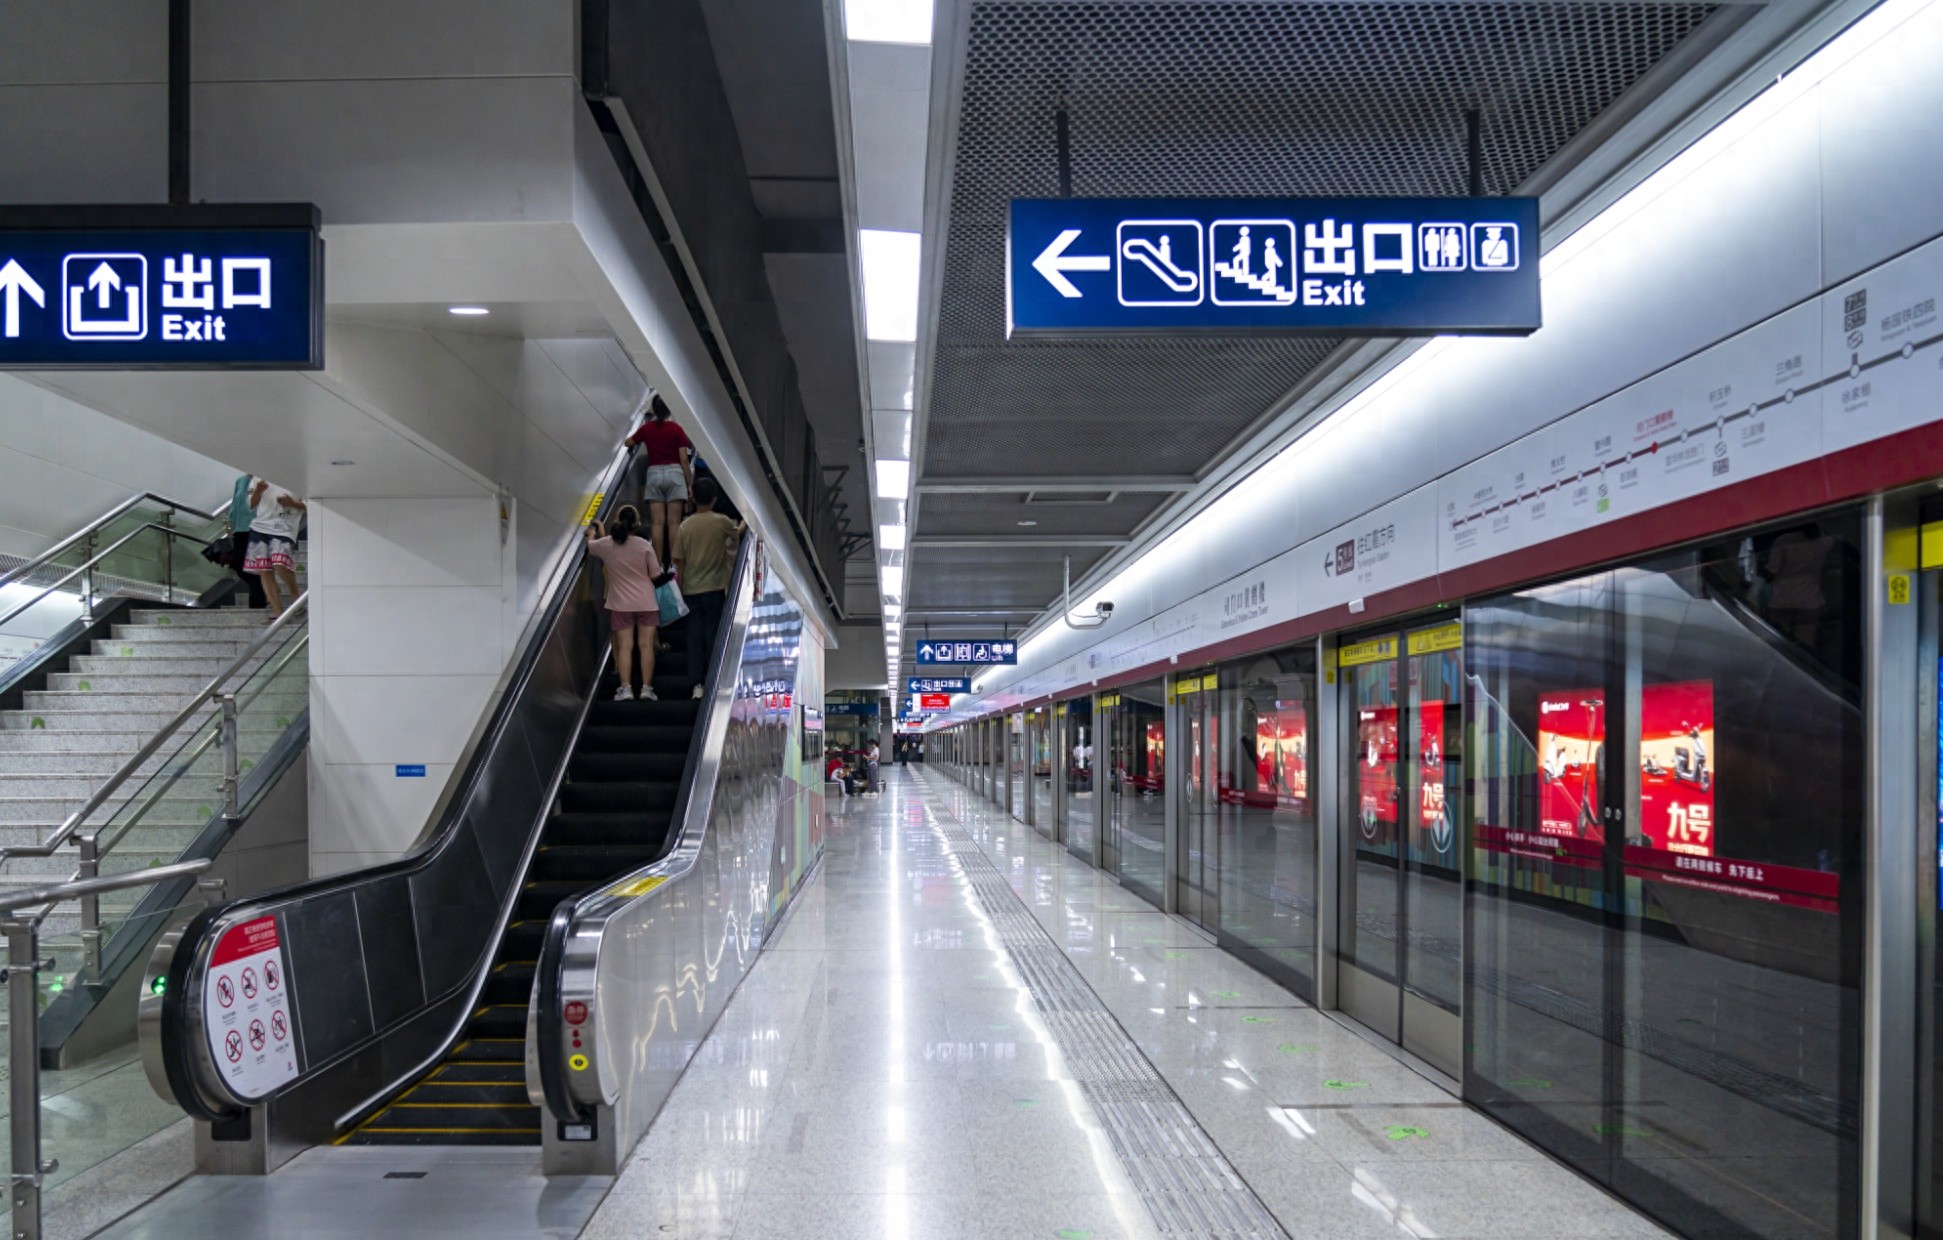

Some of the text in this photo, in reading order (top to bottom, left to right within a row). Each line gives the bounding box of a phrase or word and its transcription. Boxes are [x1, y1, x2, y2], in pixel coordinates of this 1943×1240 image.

[1303, 218, 1414, 275] 出口
[161, 253, 272, 311] 出口
[1303, 279, 1366, 307] Exit
[161, 315, 227, 342] Exit
[1666, 801, 1712, 843] 九号
[1728, 863, 1764, 882] 先下后上
